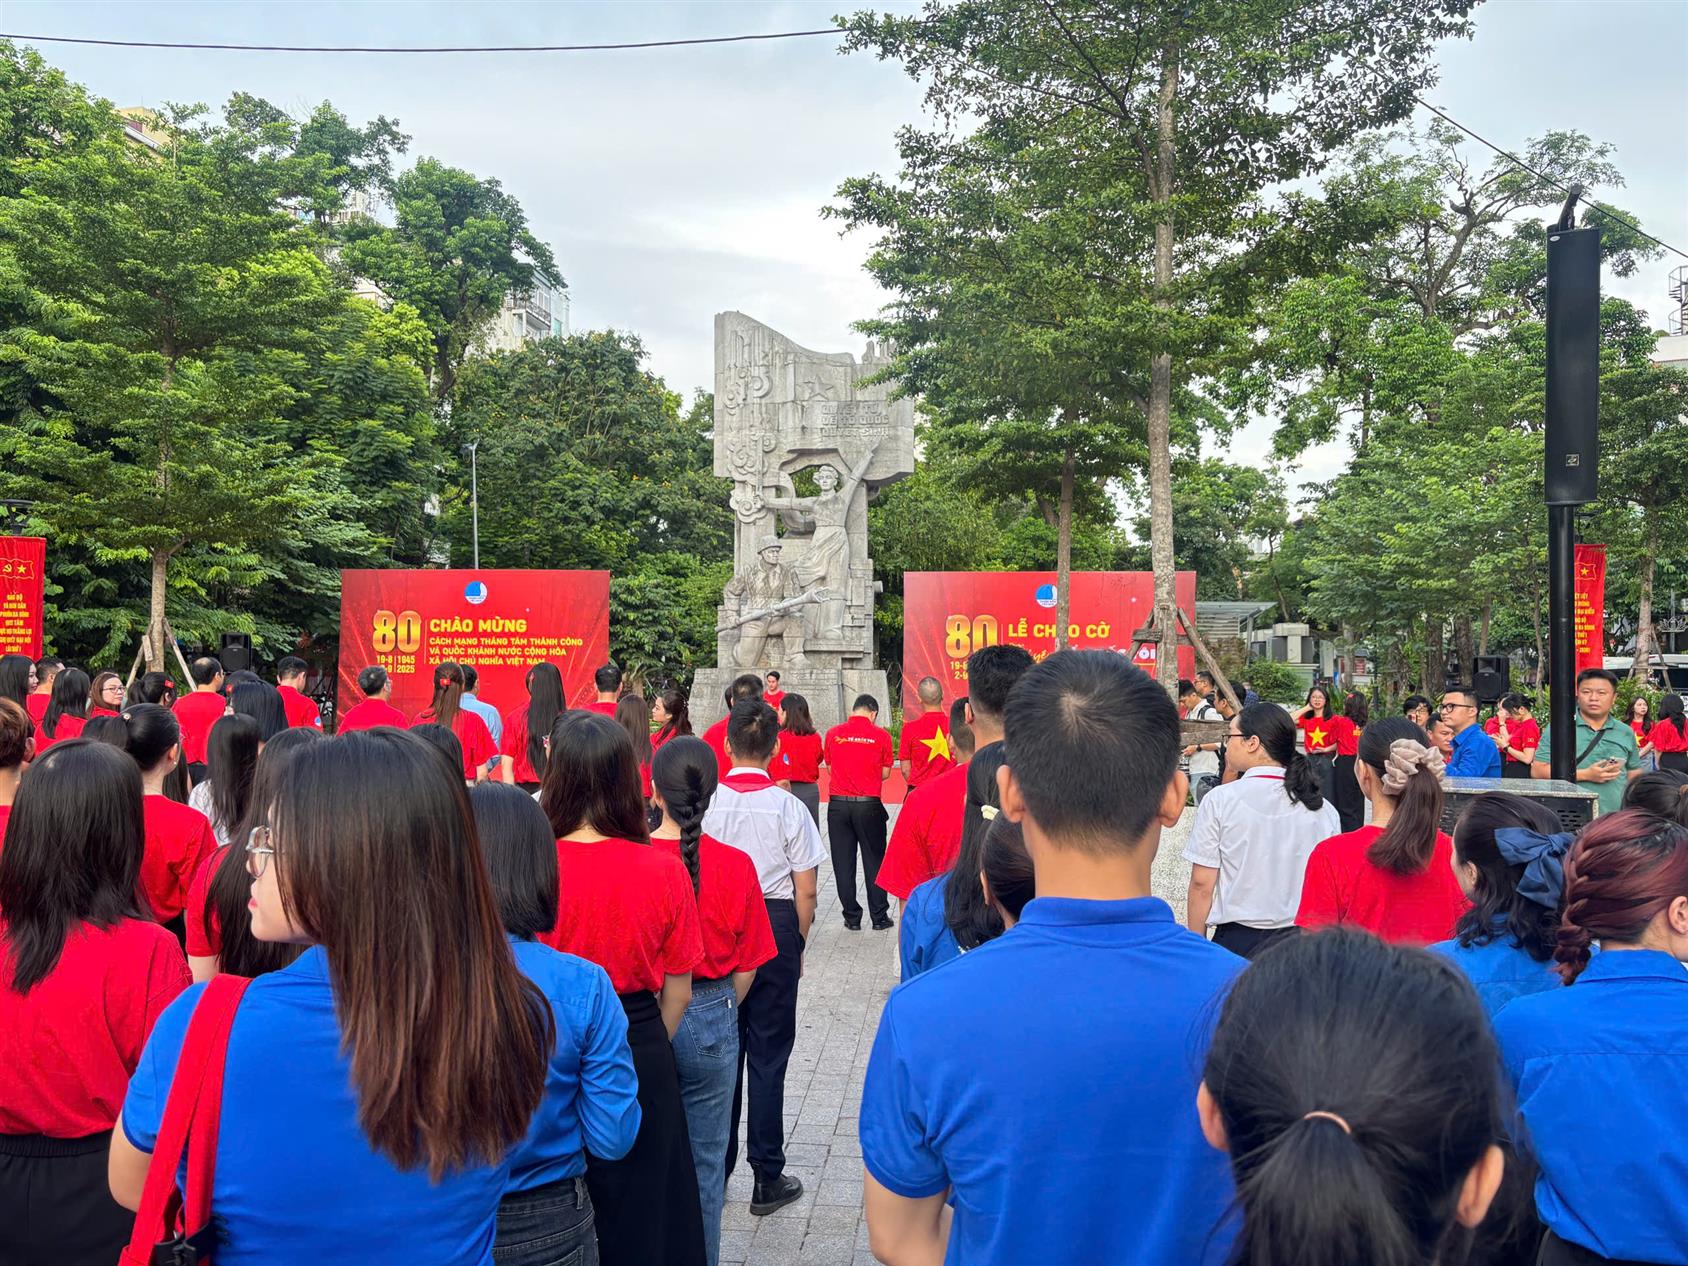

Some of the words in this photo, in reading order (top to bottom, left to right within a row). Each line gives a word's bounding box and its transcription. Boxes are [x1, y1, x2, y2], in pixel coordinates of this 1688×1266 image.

[429, 616, 473, 633] CHÀO
[478, 616, 527, 633] MỪNG
[1008, 617, 1028, 638] LỄ
[1033, 623, 1080, 638] CHO
[1085, 620, 1111, 638] CỜ
[372, 610, 421, 653] 80
[945, 614, 998, 659] 80
[429, 636, 452, 645] CÁCH
[453, 637, 478, 648] MẠNG
[480, 636, 508, 646] THÁNG
[529, 637, 558, 646] THÀNH
[560, 637, 583, 646] CÔNG
[429, 646, 441, 655] VÀ
[442, 645, 466, 655] QUỐC
[467, 646, 496, 655] KHÁNH
[497, 646, 522, 655] NƯỚC
[524, 646, 547, 657] CỘNG
[549, 647, 566, 656] HÒA
[376, 655, 393, 664] 19-8
[397, 655, 416, 664] 1945
[429, 656, 441, 665] XÃ
[459, 656, 476, 665] CHỦ
[478, 656, 504, 665] NGHĨA
[506, 655, 524, 666] VIỆT
[396, 664, 416, 674] 2025
[954, 670, 969, 680] 2-9
